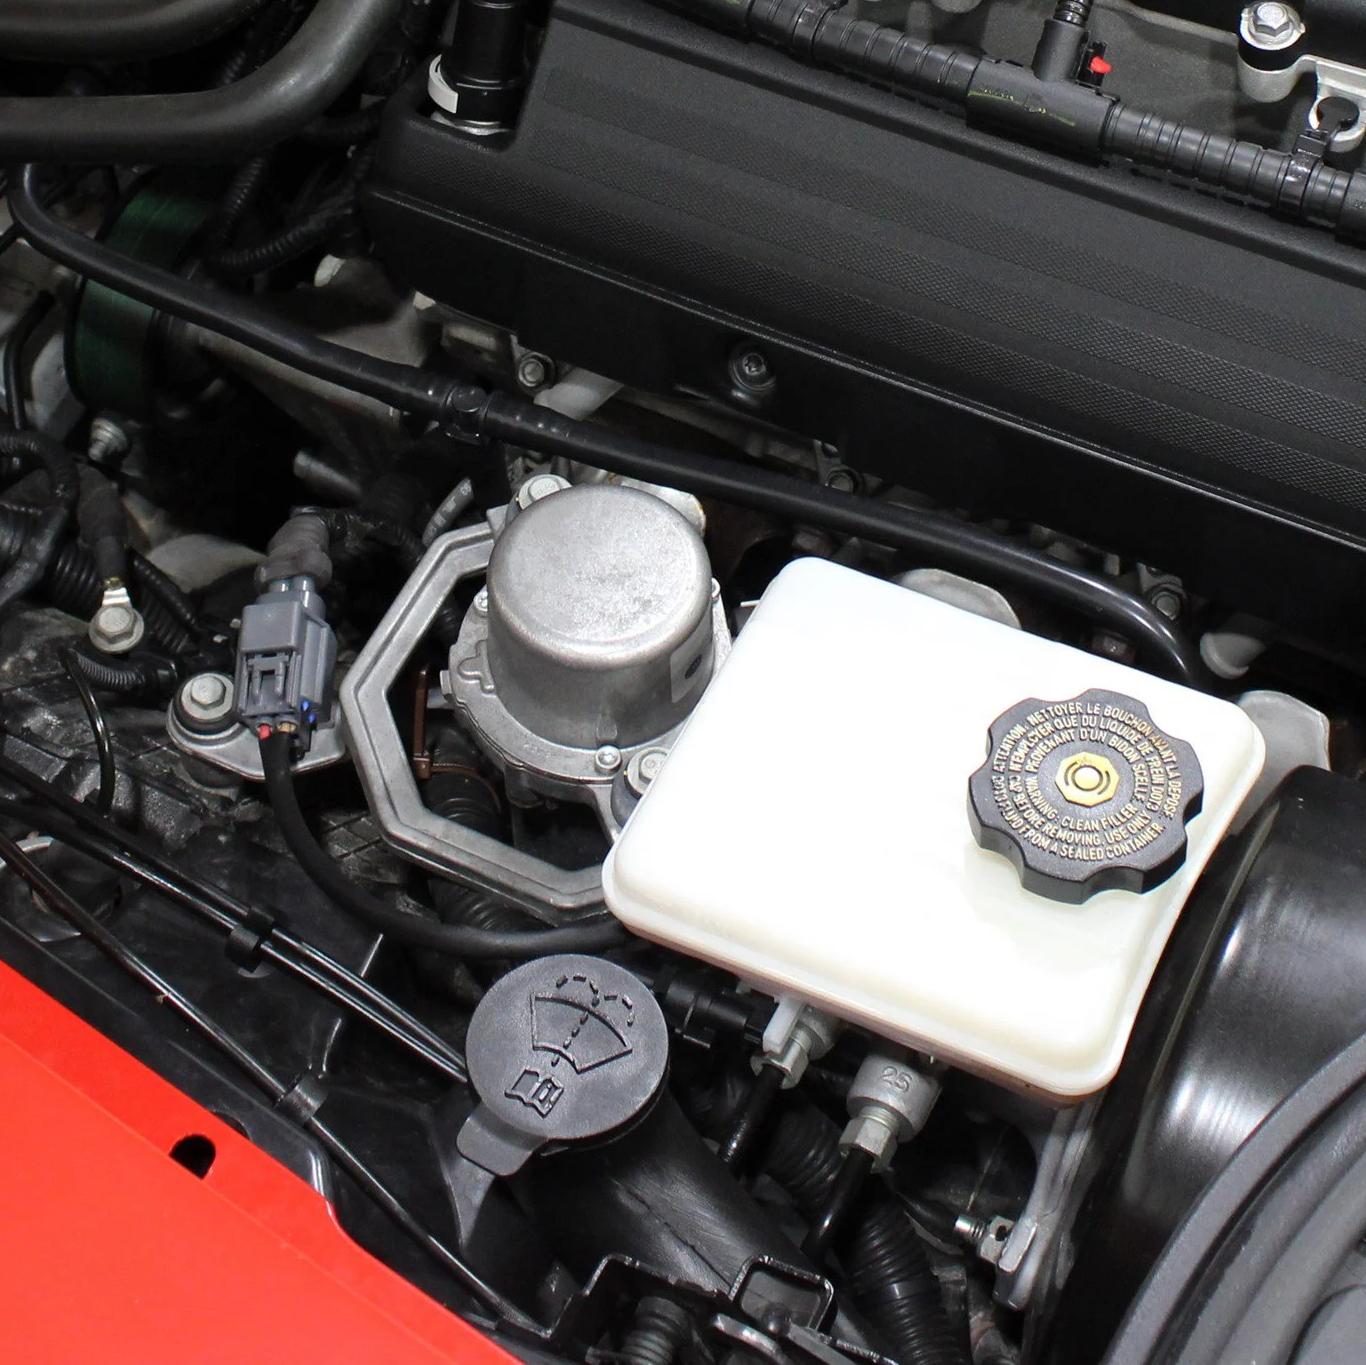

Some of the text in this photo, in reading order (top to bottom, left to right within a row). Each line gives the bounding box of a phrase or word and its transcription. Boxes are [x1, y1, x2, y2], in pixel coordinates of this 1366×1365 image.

[1025, 729, 1075, 773] PROVENANT
[1080, 728, 1107, 742] D'UN
[1108, 735, 1141, 764] BIDON
[1026, 702, 1083, 726] NETTOYER
[1087, 702, 1101, 714] LE
[1104, 705, 1154, 737] BOUCHON
[1149, 735, 1177, 763] AVANT
[1166, 765, 1181, 779] LA
[1054, 715, 1078, 730] QUE
[1081, 715, 1097, 727] DU
[1099, 717, 1142, 745] LIQUIDE
[1136, 741, 1154, 756] DE
[1146, 756, 1164, 784] FREIN
[1013, 793, 1045, 829] BEFORE
[1105, 830, 1129, 844] USE
[1127, 810, 1151, 835] ONLY
[1025, 776, 1138, 831] WARNING: CLEAN FILLER
[1018, 825, 1050, 851] FROM
[1050, 843, 1058, 854] A
[1060, 845, 1103, 861] SEALED
[881, 1065, 912, 1092] 25
